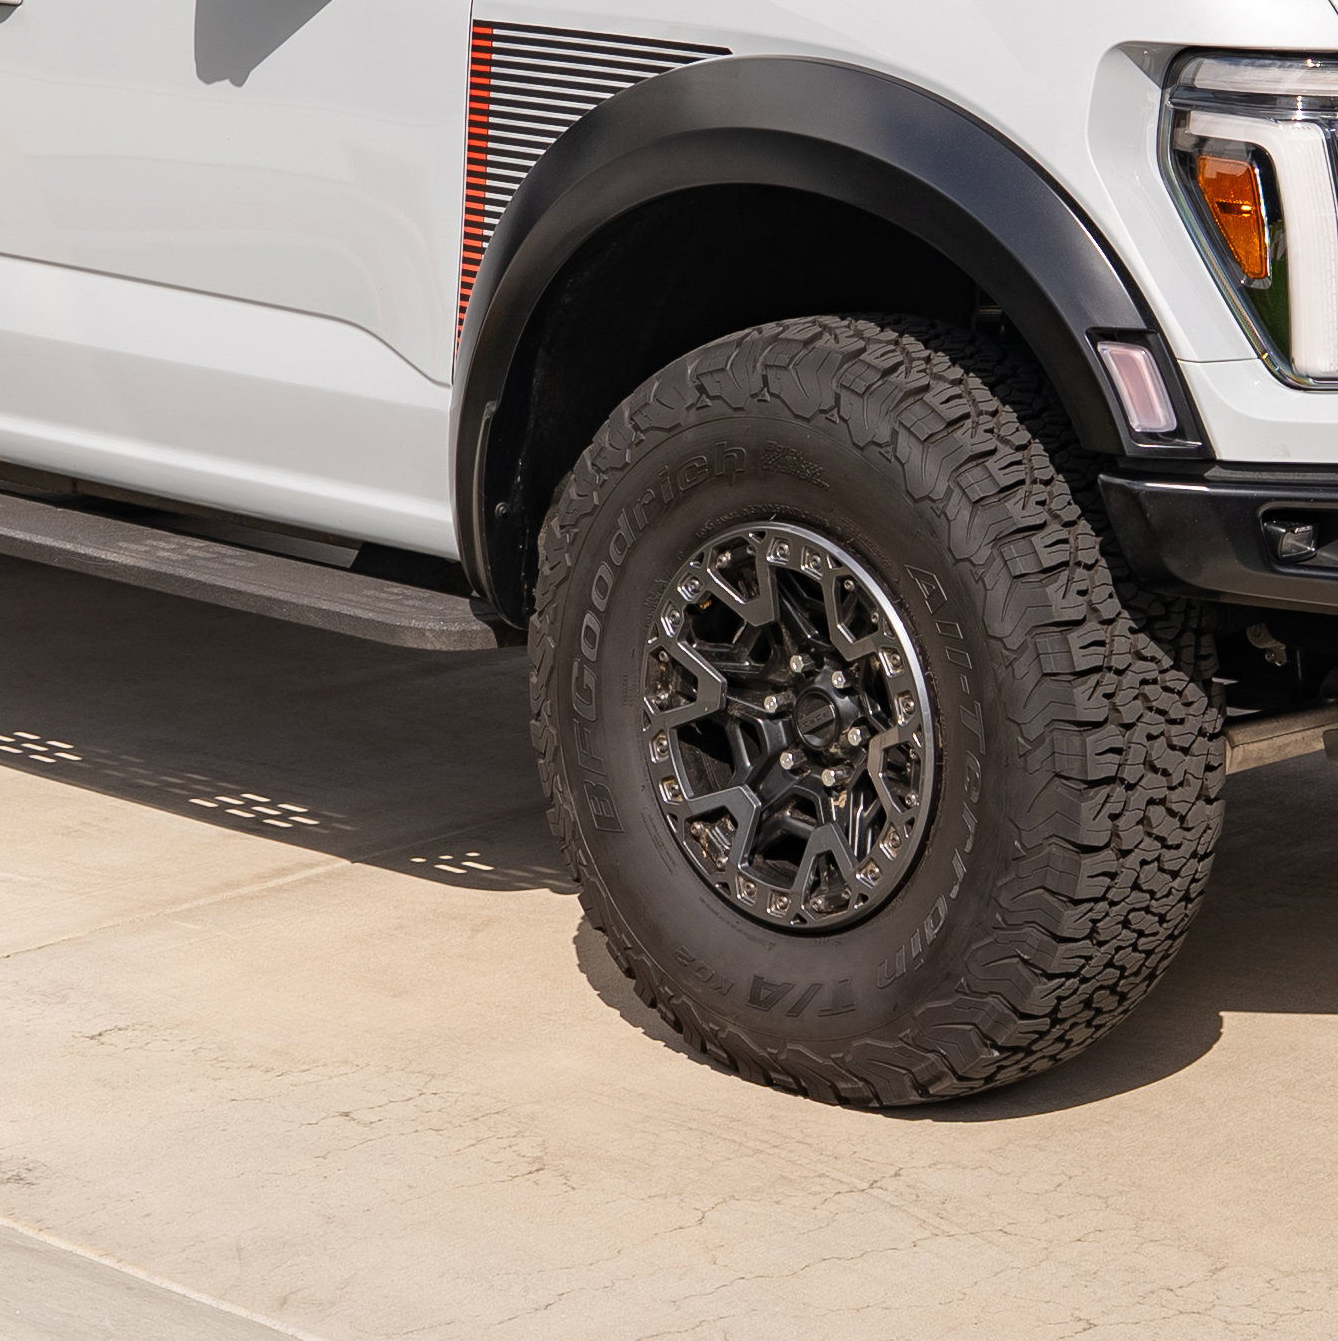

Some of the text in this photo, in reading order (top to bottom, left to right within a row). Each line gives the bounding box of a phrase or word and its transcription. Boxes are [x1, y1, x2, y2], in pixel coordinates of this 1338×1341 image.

[572, 441, 747, 833] BFGoodrich
[877, 564, 987, 990] All-Terrain
[747, 972, 857, 1017] T/A
